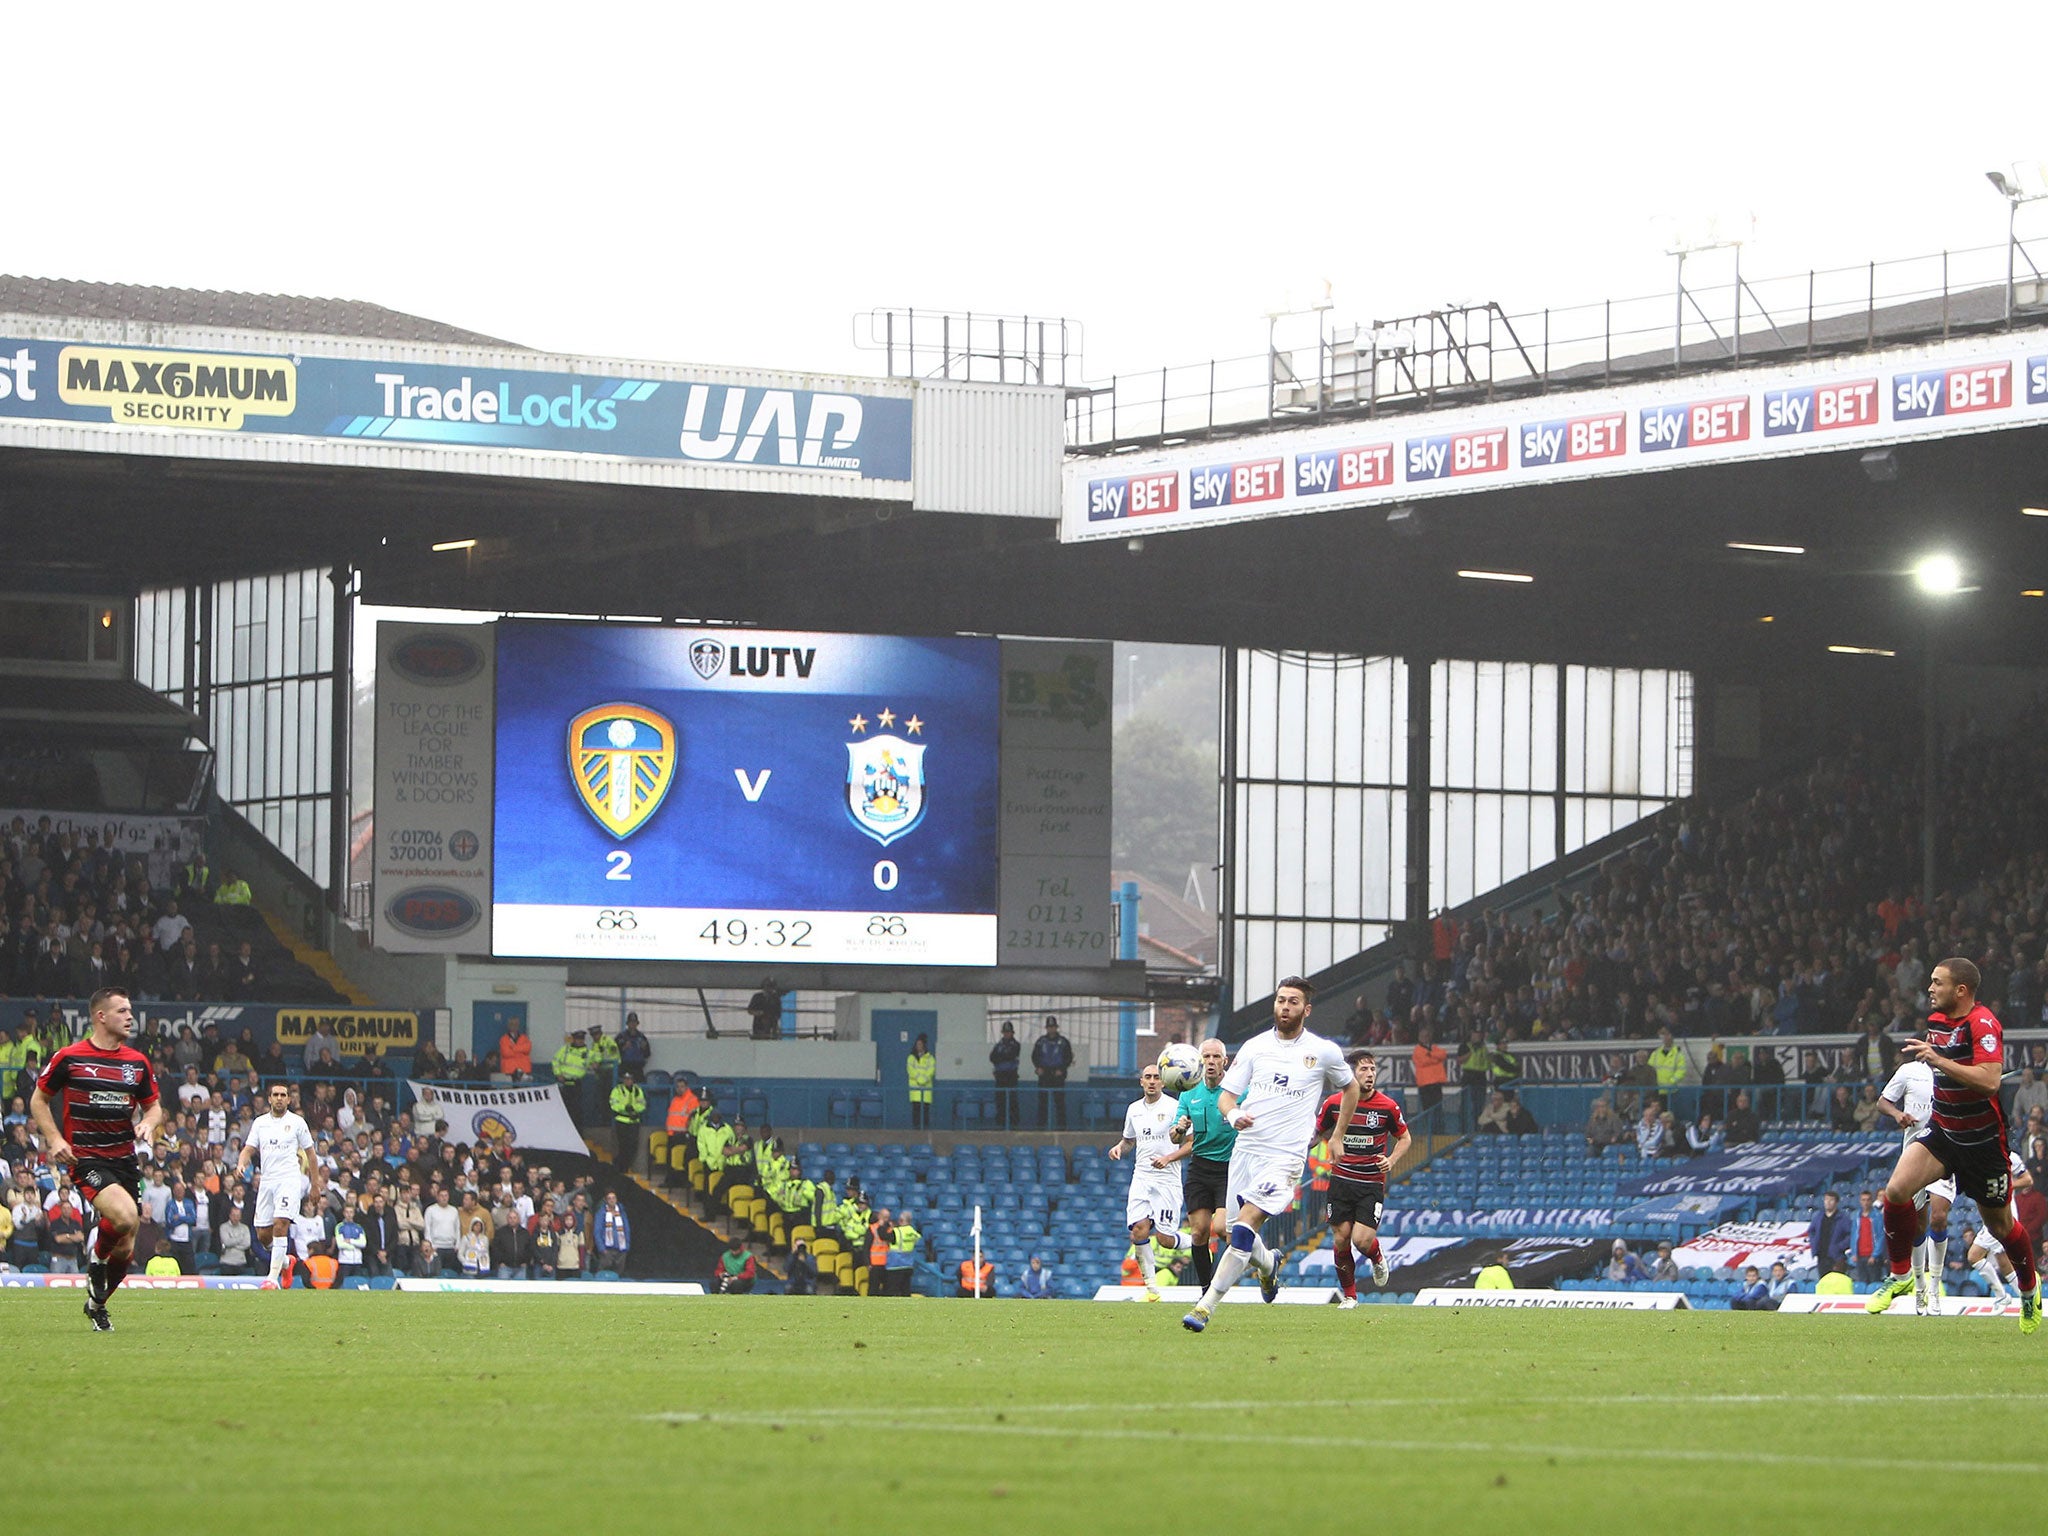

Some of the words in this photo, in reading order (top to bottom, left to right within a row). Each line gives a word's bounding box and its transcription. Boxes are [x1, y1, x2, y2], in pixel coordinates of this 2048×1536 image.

[375, 372, 617, 432] TradeLocks
[1898, 374, 1940, 418] sky
[1949, 366, 2006, 408] BET
[122, 401, 232, 423] SECURITY
[1767, 391, 1809, 433] sky
[1818, 384, 1873, 425] BET
[679, 384, 863, 465] UAP
[1643, 409, 1683, 450] sky
[1692, 401, 1745, 441] BET
[1524, 425, 1563, 464] sky
[1571, 417, 1622, 456] BET
[817, 456, 861, 470] LIMITED
[1409, 440, 1447, 480] sky
[1454, 432, 1504, 472] BET
[1298, 455, 1336, 494] sky
[1341, 447, 1389, 486] BET
[1192, 468, 1228, 506] sky
[1234, 462, 1280, 500] BET
[1091, 480, 1125, 519] sky
[1130, 476, 1175, 512] BET
[730, 646, 816, 678] LUTV
[390, 703, 421, 718] TOP
[427, 703, 451, 719] OF
[455, 704, 483, 720] THE
[403, 720, 469, 736] LEAGUE
[419, 737, 452, 752] FOR
[407, 753, 463, 770] TIMBER
[392, 770, 478, 788] WINDOWS
[395, 787, 407, 802] &
[413, 788, 475, 803] DOORS
[401, 830, 443, 846] 01706
[389, 847, 443, 862] 370001
[605, 851, 632, 880] 2
[873, 861, 898, 891] 0
[404, 899, 460, 923] PDS
[1028, 904, 1083, 923] 0113
[699, 919, 813, 948] 49:32
[1006, 929, 1106, 949] 2311470
[434, 1089, 551, 1106] MBRIDGESHIRE
[281, 1197, 289, 1207] 5
[1160, 1209, 1174, 1222] 14
